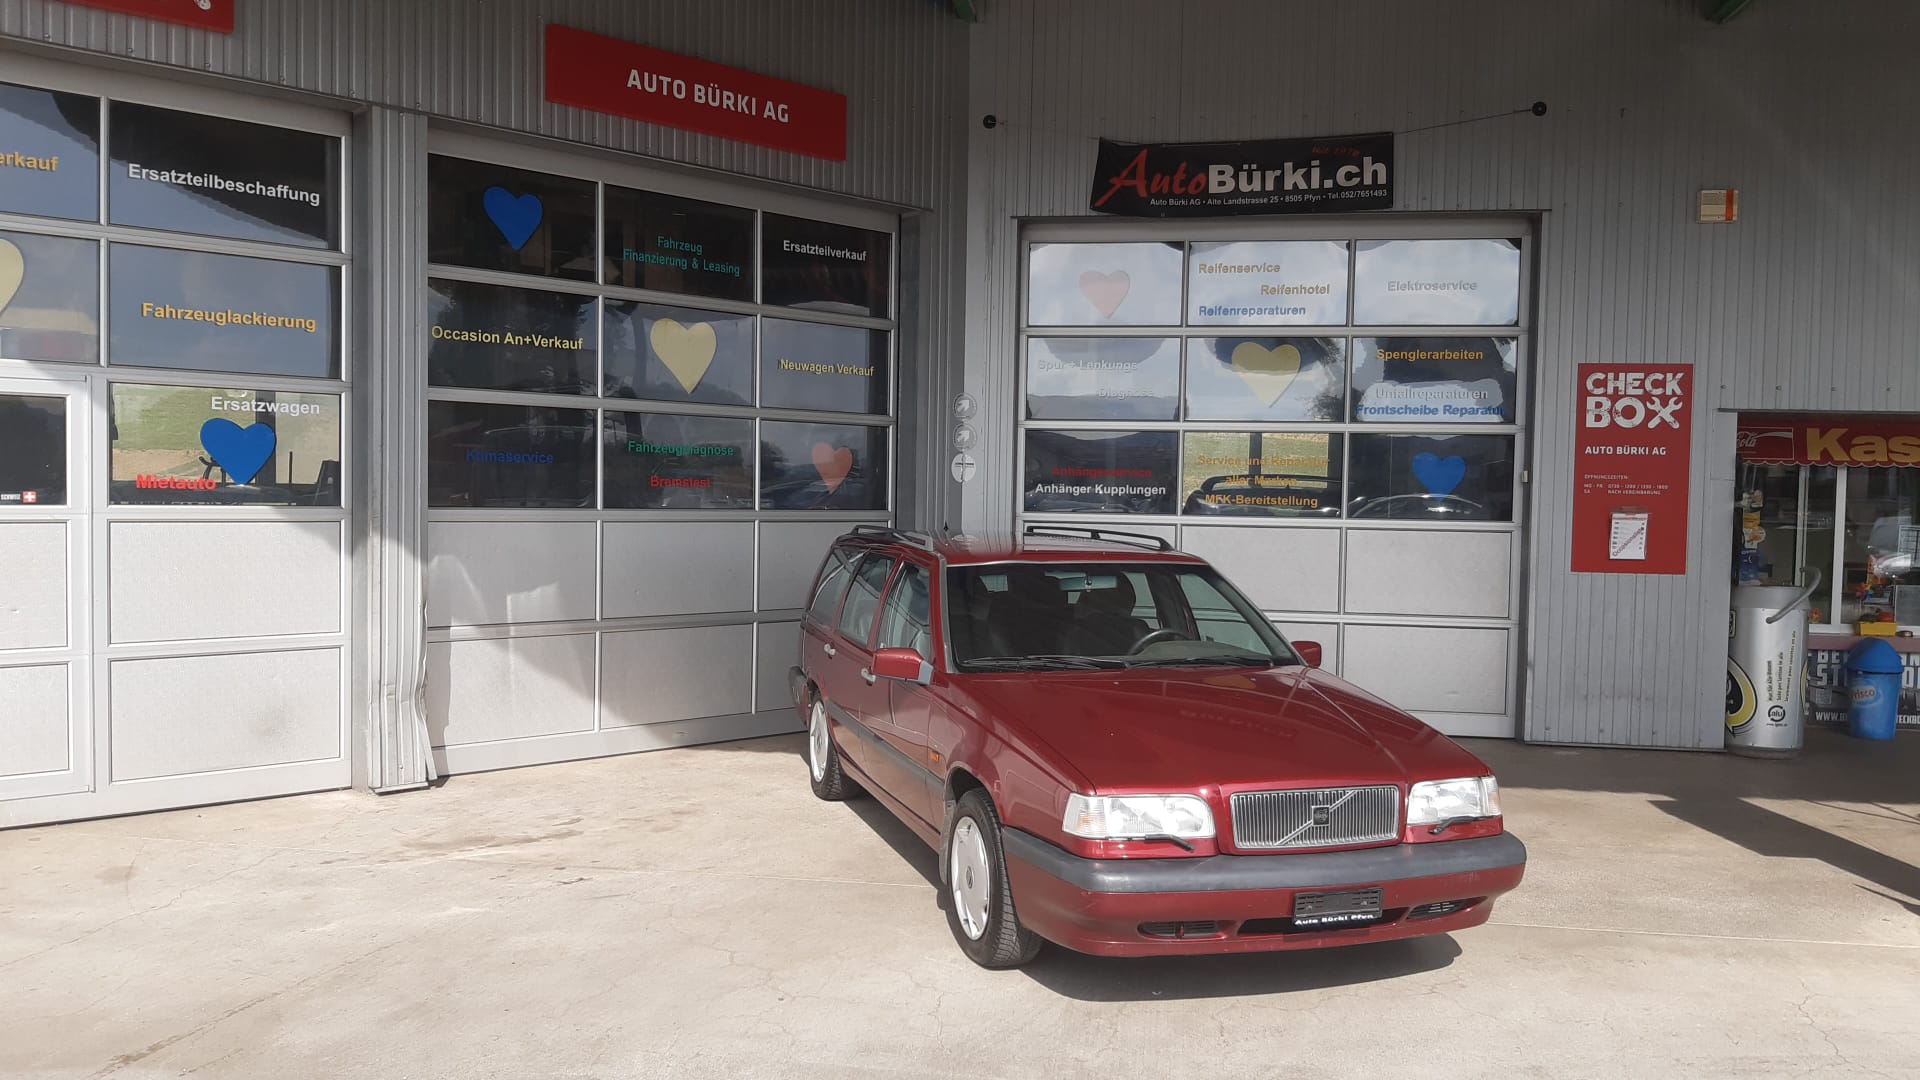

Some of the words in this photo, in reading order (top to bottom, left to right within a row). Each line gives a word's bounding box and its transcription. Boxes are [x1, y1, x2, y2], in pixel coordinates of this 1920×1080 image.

[627, 69, 686, 99] AUTO
[694, 83, 756, 115] BÜRKI
[763, 101, 789, 123] AG
[128, 163, 320, 206] Ersatzteilbeschaffung
[1150, 198, 1169, 206] Auto
[1169, 196, 1188, 206] Bürki
[1190, 198, 1201, 206] AG
[1223, 195, 1268, 205] Landstrasse
[1270, 195, 1279, 204] 25
[1284, 194, 1303, 203] 8505
[1304, 193, 1321, 204] Pfyn
[657, 235, 703, 256] Fahrzeug
[783, 239, 868, 262] Ersatzteilverkauf
[623, 248, 688, 271] Finanzierung
[691, 257, 699, 270] &
[703, 259, 740, 278] Leasing
[1199, 263, 1281, 274] Reifenservice
[1260, 284, 1331, 296] Reifenhotel
[1388, 280, 1478, 292] Elektroservice
[142, 302, 317, 333] Fahrzeuglackierung
[1199, 305, 1306, 318] Reifenreparaturen
[431, 325, 500, 344] Occasion
[504, 331, 584, 350] An+Verkauf
[1376, 348, 1484, 362] Spenglerarbeiten
[780, 358, 834, 375] Neuwagen
[837, 363, 875, 377] Verkauf
[1586, 372, 1685, 396] CHECK
[1376, 388, 1488, 401] Unfallreparaturen
[211, 396, 320, 417] Ersatzwagen
[1356, 404, 1439, 416] Frontscheibe
[1585, 446, 1613, 455] AUTO
[1616, 445, 1649, 455] BÜRKI
[1652, 446, 1667, 455] AG
[1199, 455, 1242, 466] Service
[1246, 455, 1267, 466] und
[136, 474, 217, 491] Mietauto
[1035, 482, 1092, 496] Anhänger
[1095, 483, 1166, 497] Kupplungen
[1205, 494, 1318, 509] MFK-Bereitstellung
